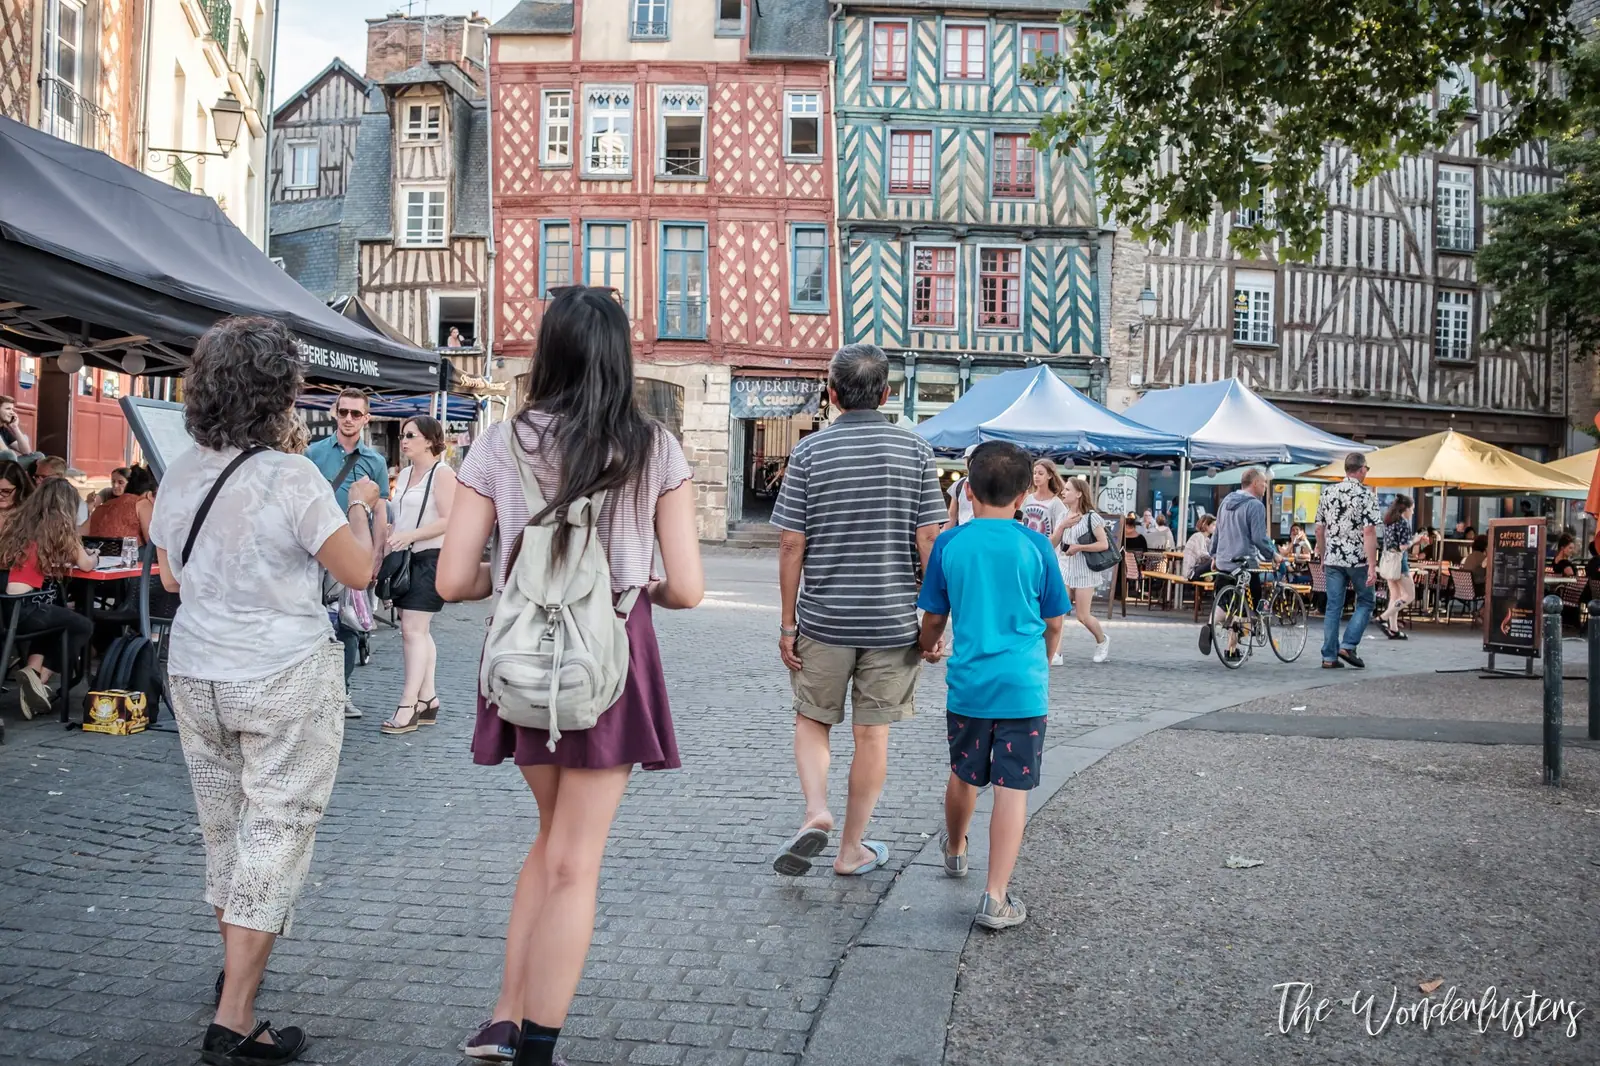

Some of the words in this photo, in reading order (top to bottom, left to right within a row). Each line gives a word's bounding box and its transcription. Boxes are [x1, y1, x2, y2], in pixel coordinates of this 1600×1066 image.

[329, 350, 359, 373] SAINTE
[359, 358, 380, 377] ANNE
[746, 395, 759, 406] LA
